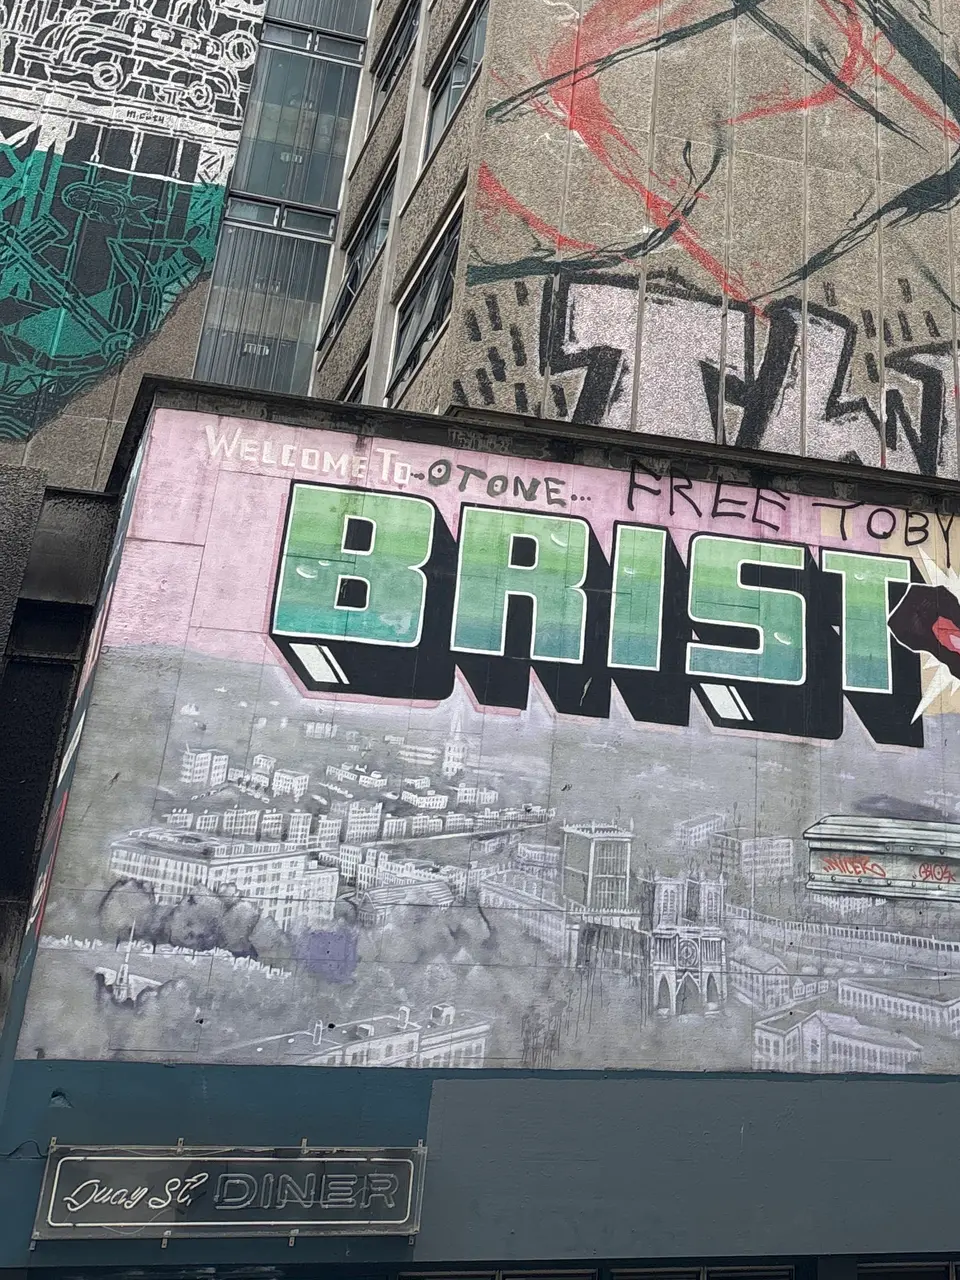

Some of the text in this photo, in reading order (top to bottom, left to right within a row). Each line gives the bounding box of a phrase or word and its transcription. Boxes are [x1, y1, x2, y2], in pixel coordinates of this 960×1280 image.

[205, 425, 368, 478] WELCOME
[627, 460, 791, 532] FREE
[812, 500, 955, 568] TOBY
[63, 1179, 148, 1212] Quay
[213, 1173, 399, 1210] DINER
